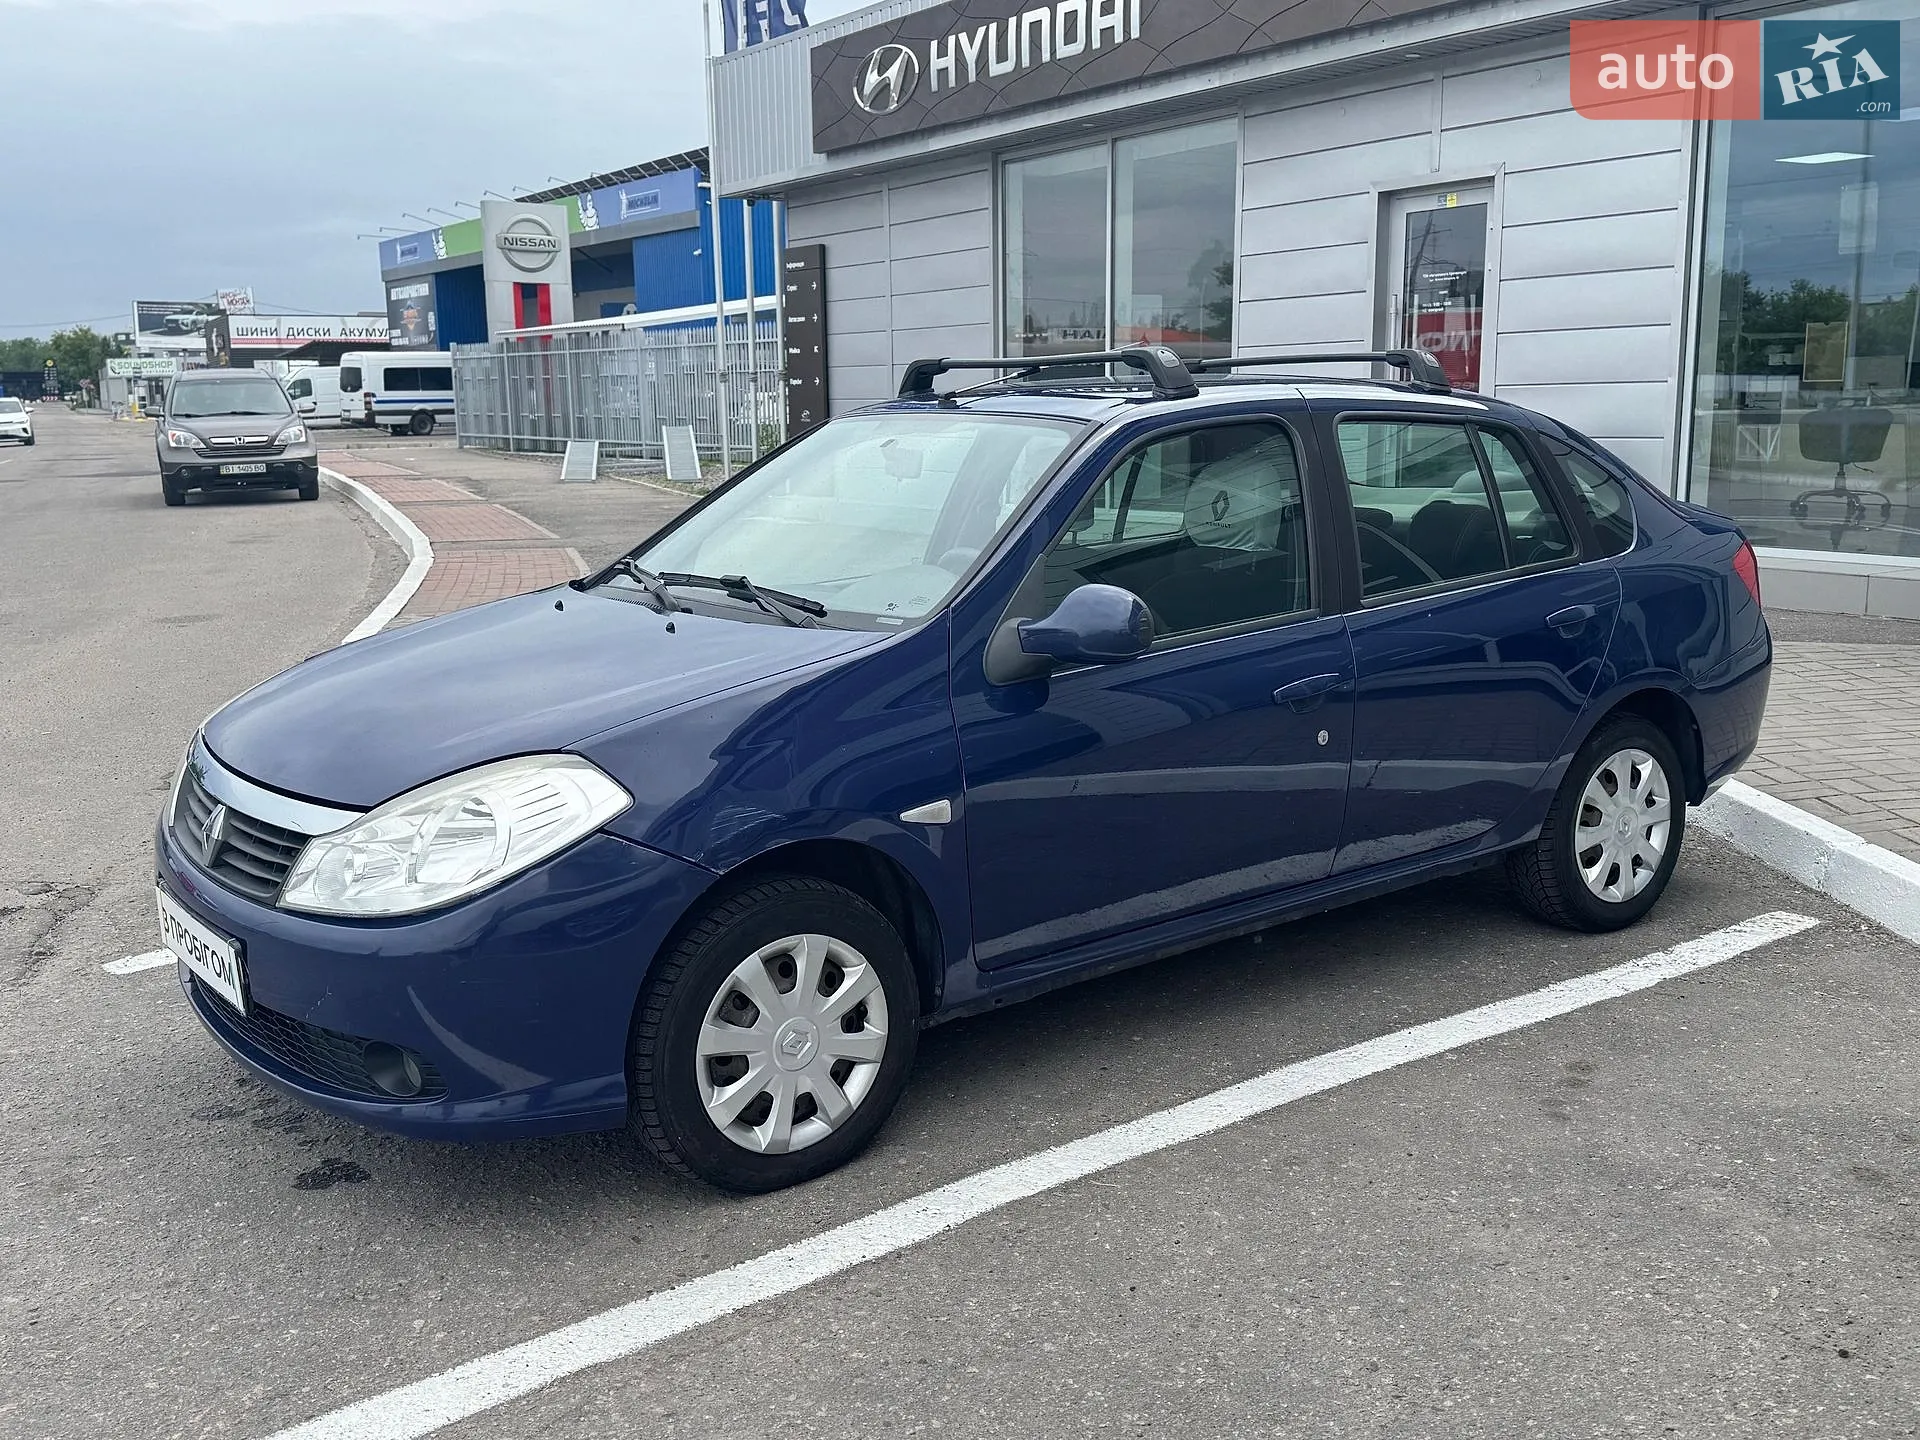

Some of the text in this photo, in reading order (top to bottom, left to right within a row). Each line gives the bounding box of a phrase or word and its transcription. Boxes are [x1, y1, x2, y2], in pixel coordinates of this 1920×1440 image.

[930, 0, 1141, 93] HYUNDAI
[503, 236, 557, 249] NISSAN
[236, 326, 279, 337] ШИНИ
[286, 326, 331, 339] ДИСКИ
[169, 913, 234, 986] ПРОБІГОМ
